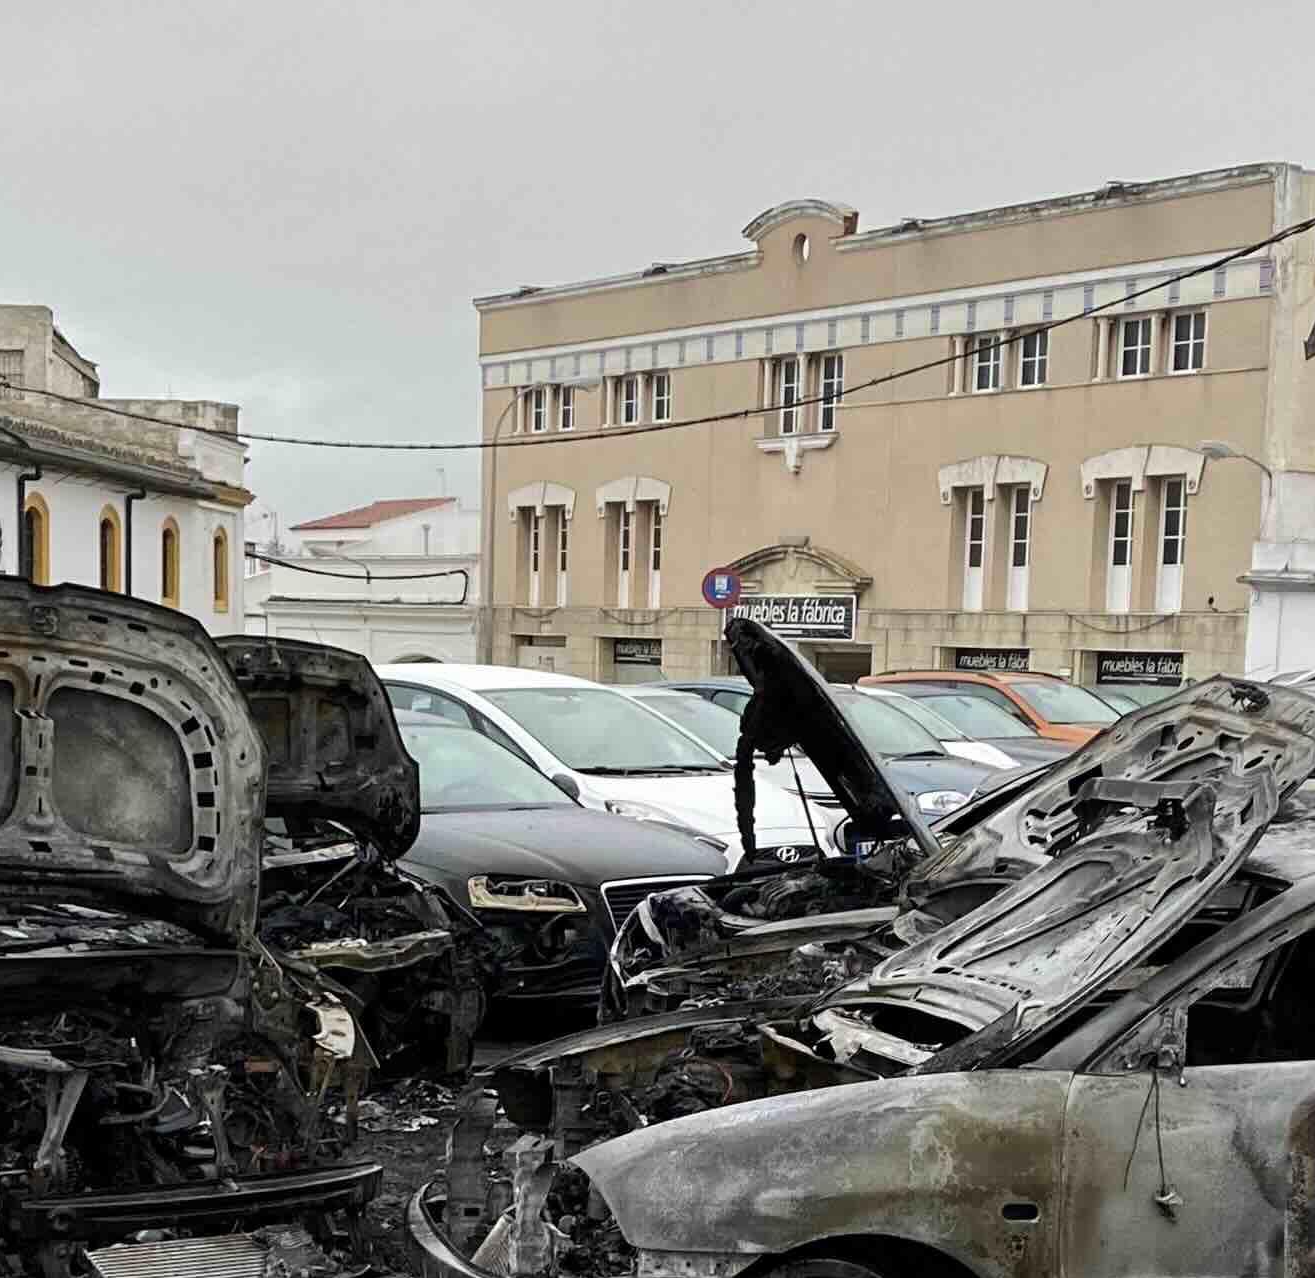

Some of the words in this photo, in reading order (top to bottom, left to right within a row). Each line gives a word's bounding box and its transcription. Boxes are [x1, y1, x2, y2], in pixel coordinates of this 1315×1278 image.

[733, 599, 785, 622] muebles
[787, 599, 799, 622] la
[801, 597, 845, 623] fábrica
[959, 653, 996, 668] muebles
[998, 653, 1006, 668] la
[1101, 655, 1144, 672] muebles
[1146, 655, 1156, 672] la
